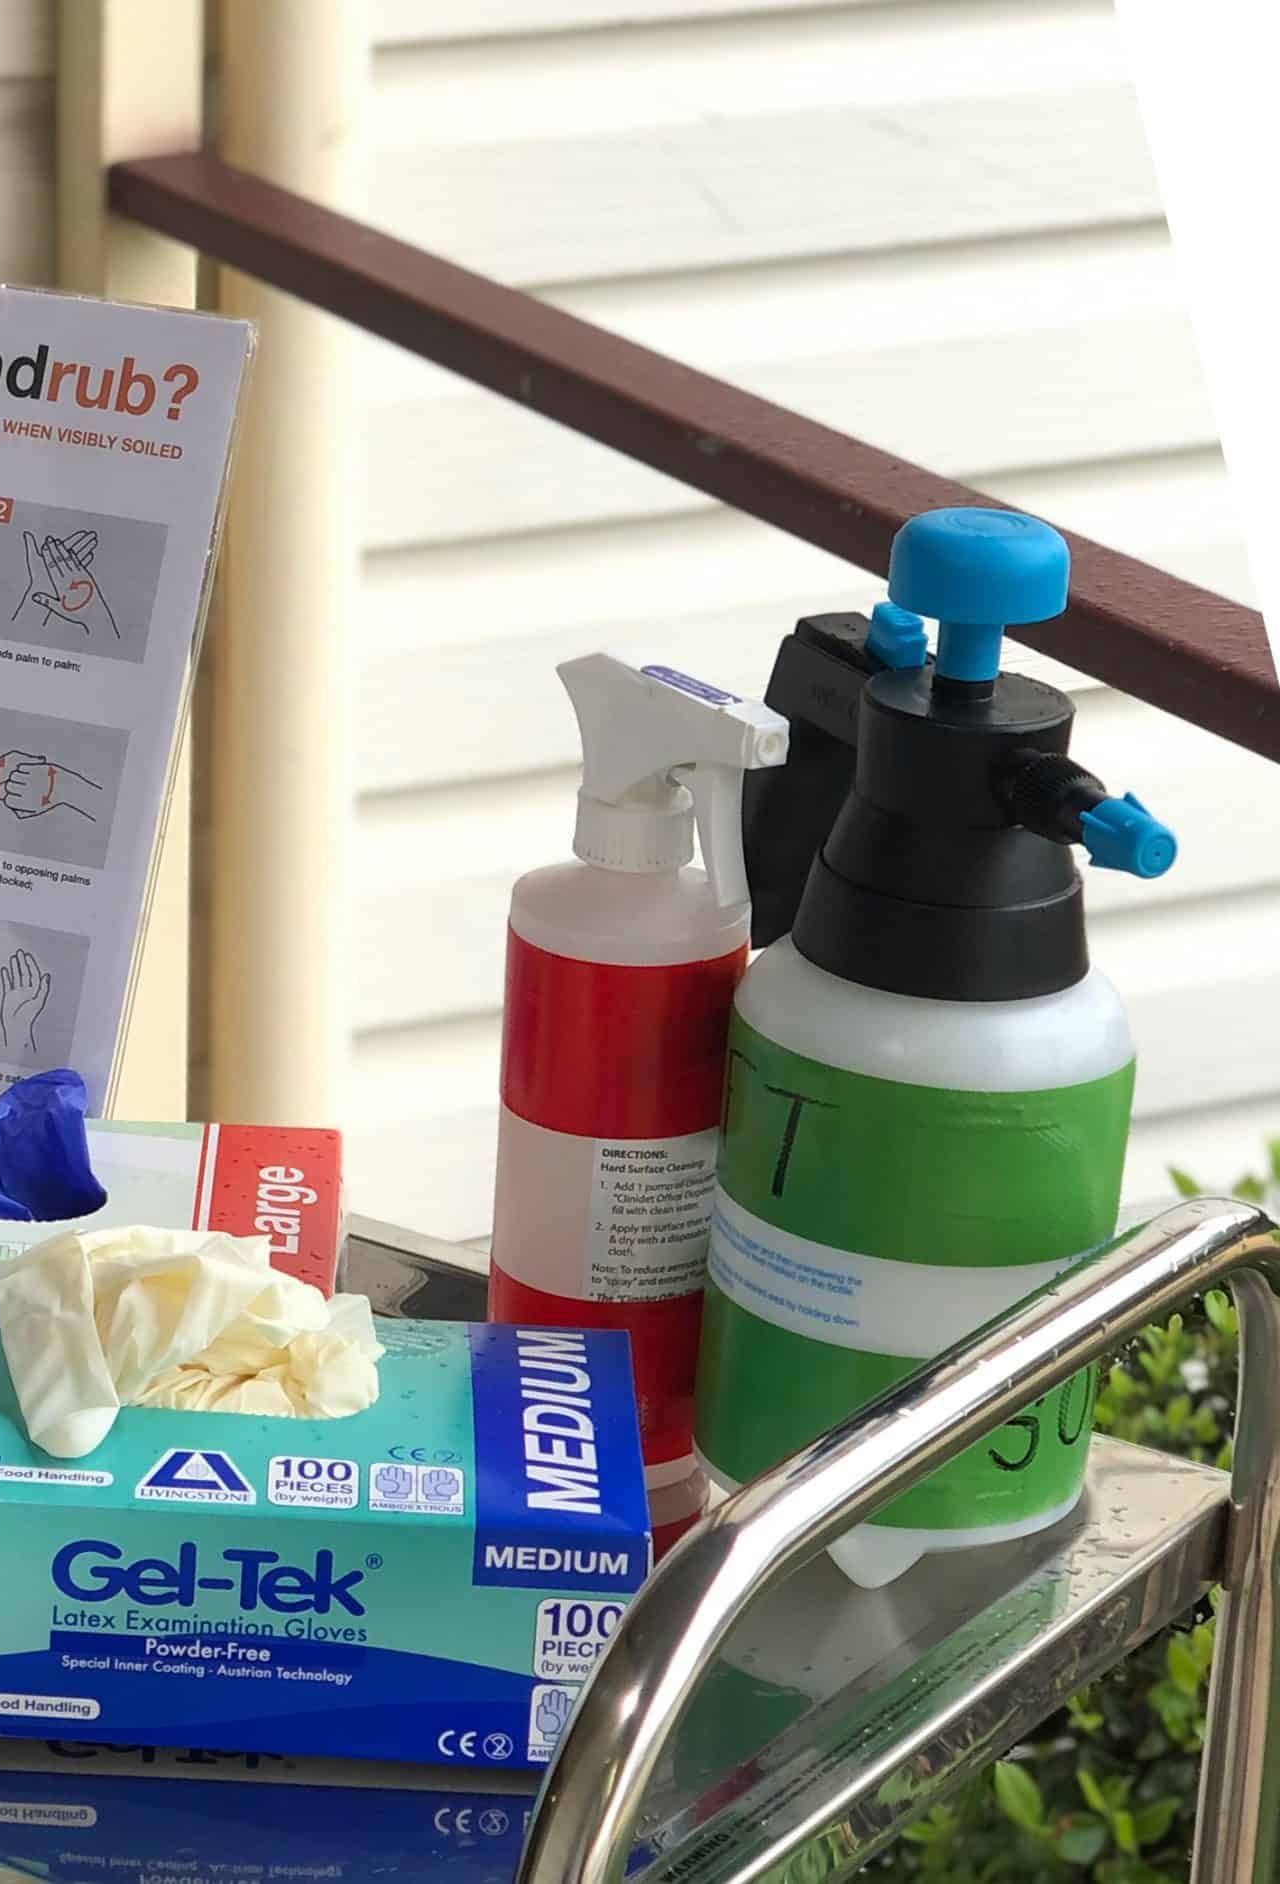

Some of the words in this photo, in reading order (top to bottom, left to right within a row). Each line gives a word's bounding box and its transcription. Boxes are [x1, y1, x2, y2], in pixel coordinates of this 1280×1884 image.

[3, 419, 52, 439] WHEN
[58, 428, 117, 448] VISIBLY
[121, 438, 182, 459] SOILED
[15, 653, 39, 663] palm
[41, 656, 51, 666] to
[53, 660, 80, 672] palm;
[2, 861, 12, 870] to
[14, 865, 58, 881] opposing
[60, 873, 90, 885] palms
[602, 1148, 668, 1159] DIRECTIONS:
[601, 1164, 625, 1173] Hand
[628, 1163, 664, 1173] Surface
[255, 1166, 318, 1255] Large
[516, 1329, 602, 1515] MEDIUM
[38, 1468, 104, 1483] Handling
[275, 1459, 353, 1481] 100
[275, 1480, 353, 1494] PIECES
[275, 1493, 300, 1504] (by
[304, 1495, 353, 1506] weight)
[371, 1501, 462, 1513] AMBIDEXTROUS
[484, 1545, 630, 1576] MEDIUM
[52, 1605, 116, 1629] Latex
[126, 1610, 274, 1638] Examination
[284, 1617, 368, 1642] Gloves
[144, 1638, 271, 1662] Powder-Free
[61, 1655, 110, 1669] Special
[114, 1658, 148, 1671] Inner
[152, 1660, 204, 1677] Coating
[216, 1664, 271, 1677] Austrian
[276, 1666, 351, 1685] Technology
[24, 1699, 90, 1716] Handling
